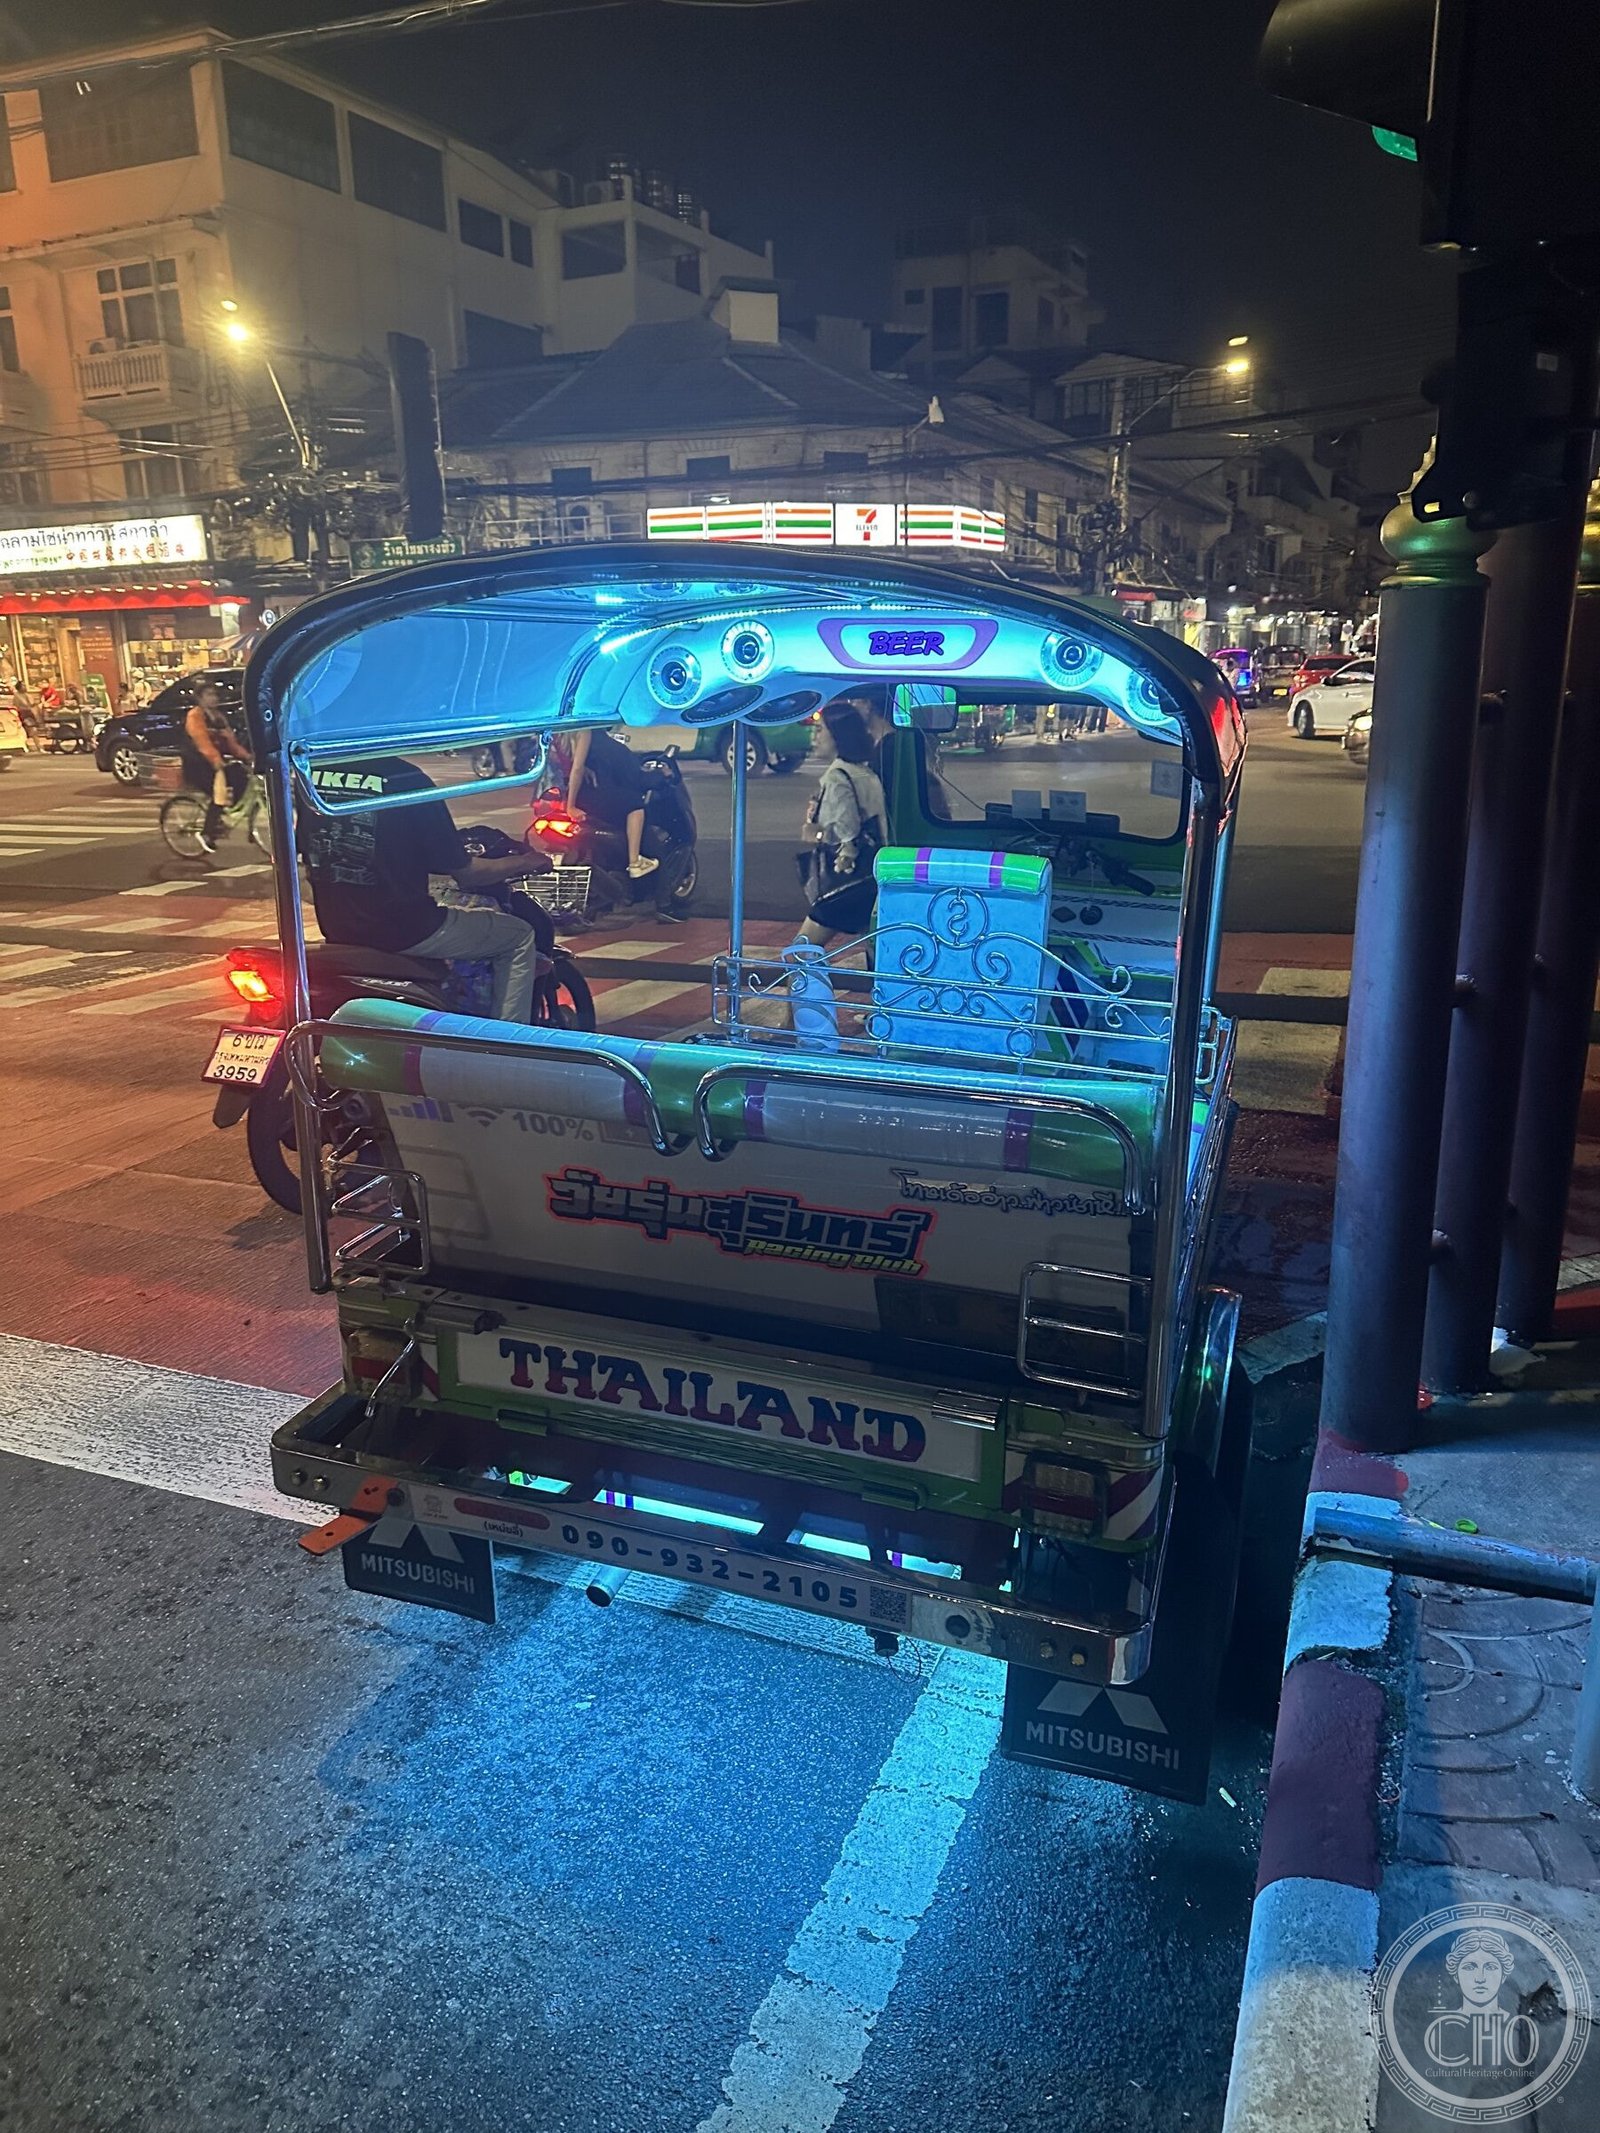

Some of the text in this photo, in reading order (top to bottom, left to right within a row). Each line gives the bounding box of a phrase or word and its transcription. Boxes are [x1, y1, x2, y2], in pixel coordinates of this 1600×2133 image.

[868, 630, 945, 656] BEER
[312, 770, 384, 793] IKEA
[213, 1064, 258, 1082] 3959
[512, 1110, 595, 1142] 100%
[742, 1237, 924, 1276] Racing Club
[500, 1337, 927, 1463] THAILAND
[361, 1552, 475, 1594] MITSUBISHI
[561, 1523, 858, 1609] 090-932-2105
[1026, 1720, 1180, 1770] MITSUBISHI
